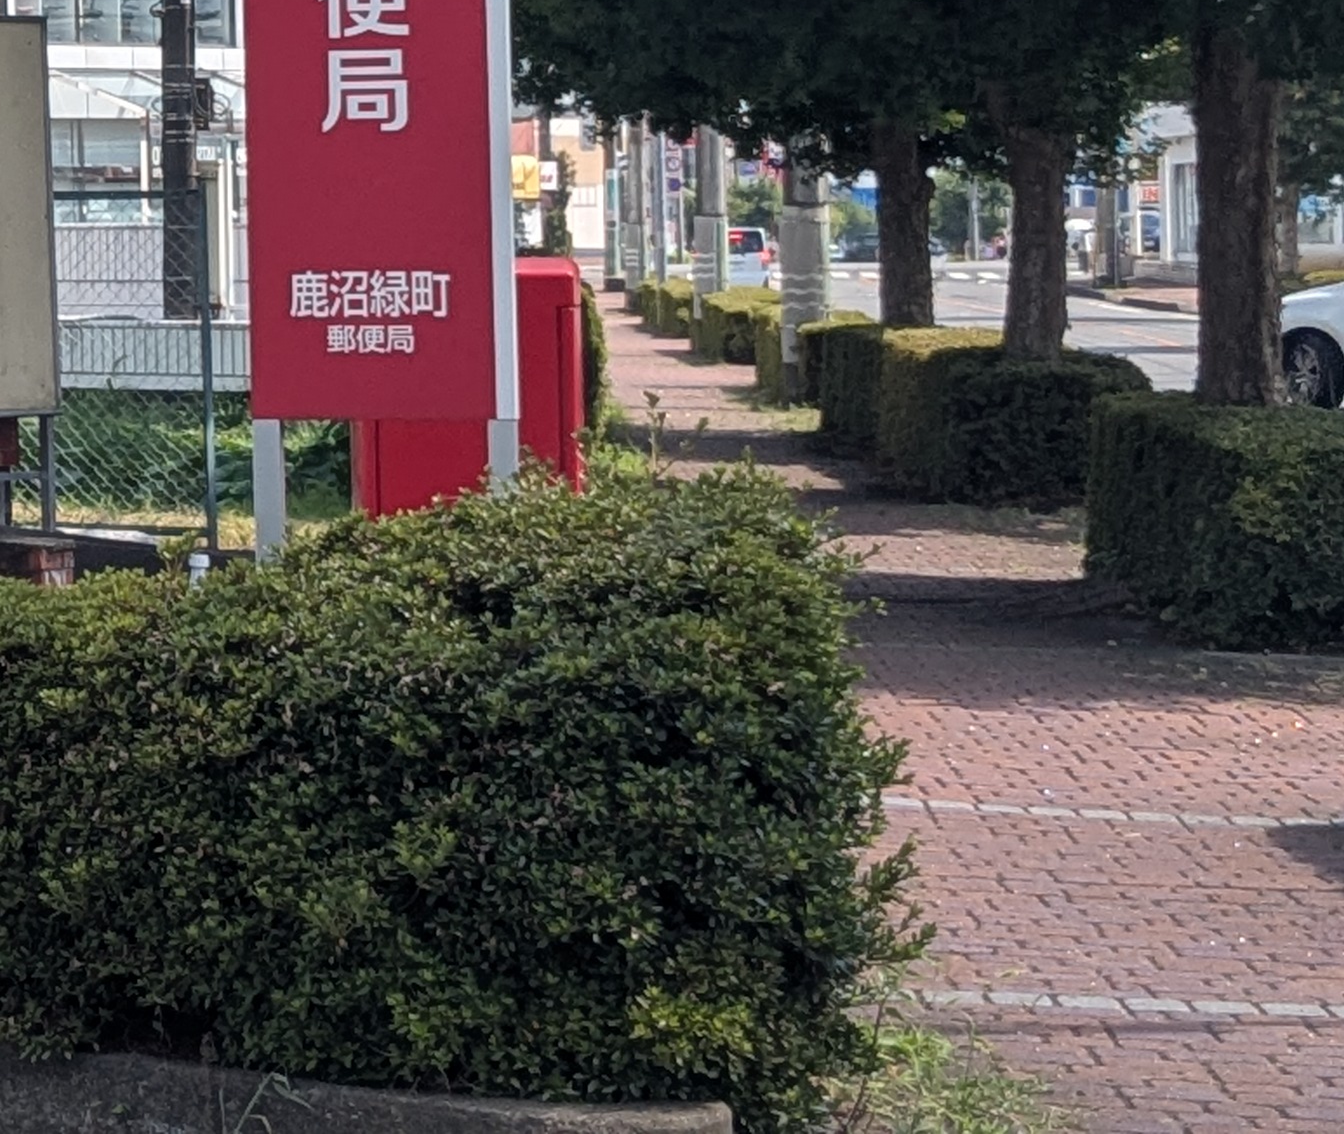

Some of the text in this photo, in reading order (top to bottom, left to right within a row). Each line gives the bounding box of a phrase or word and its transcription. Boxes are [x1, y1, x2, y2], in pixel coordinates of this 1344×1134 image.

[289, 269, 451, 319] 鹿沼緑町
[326, 324, 415, 354] 郵便局
